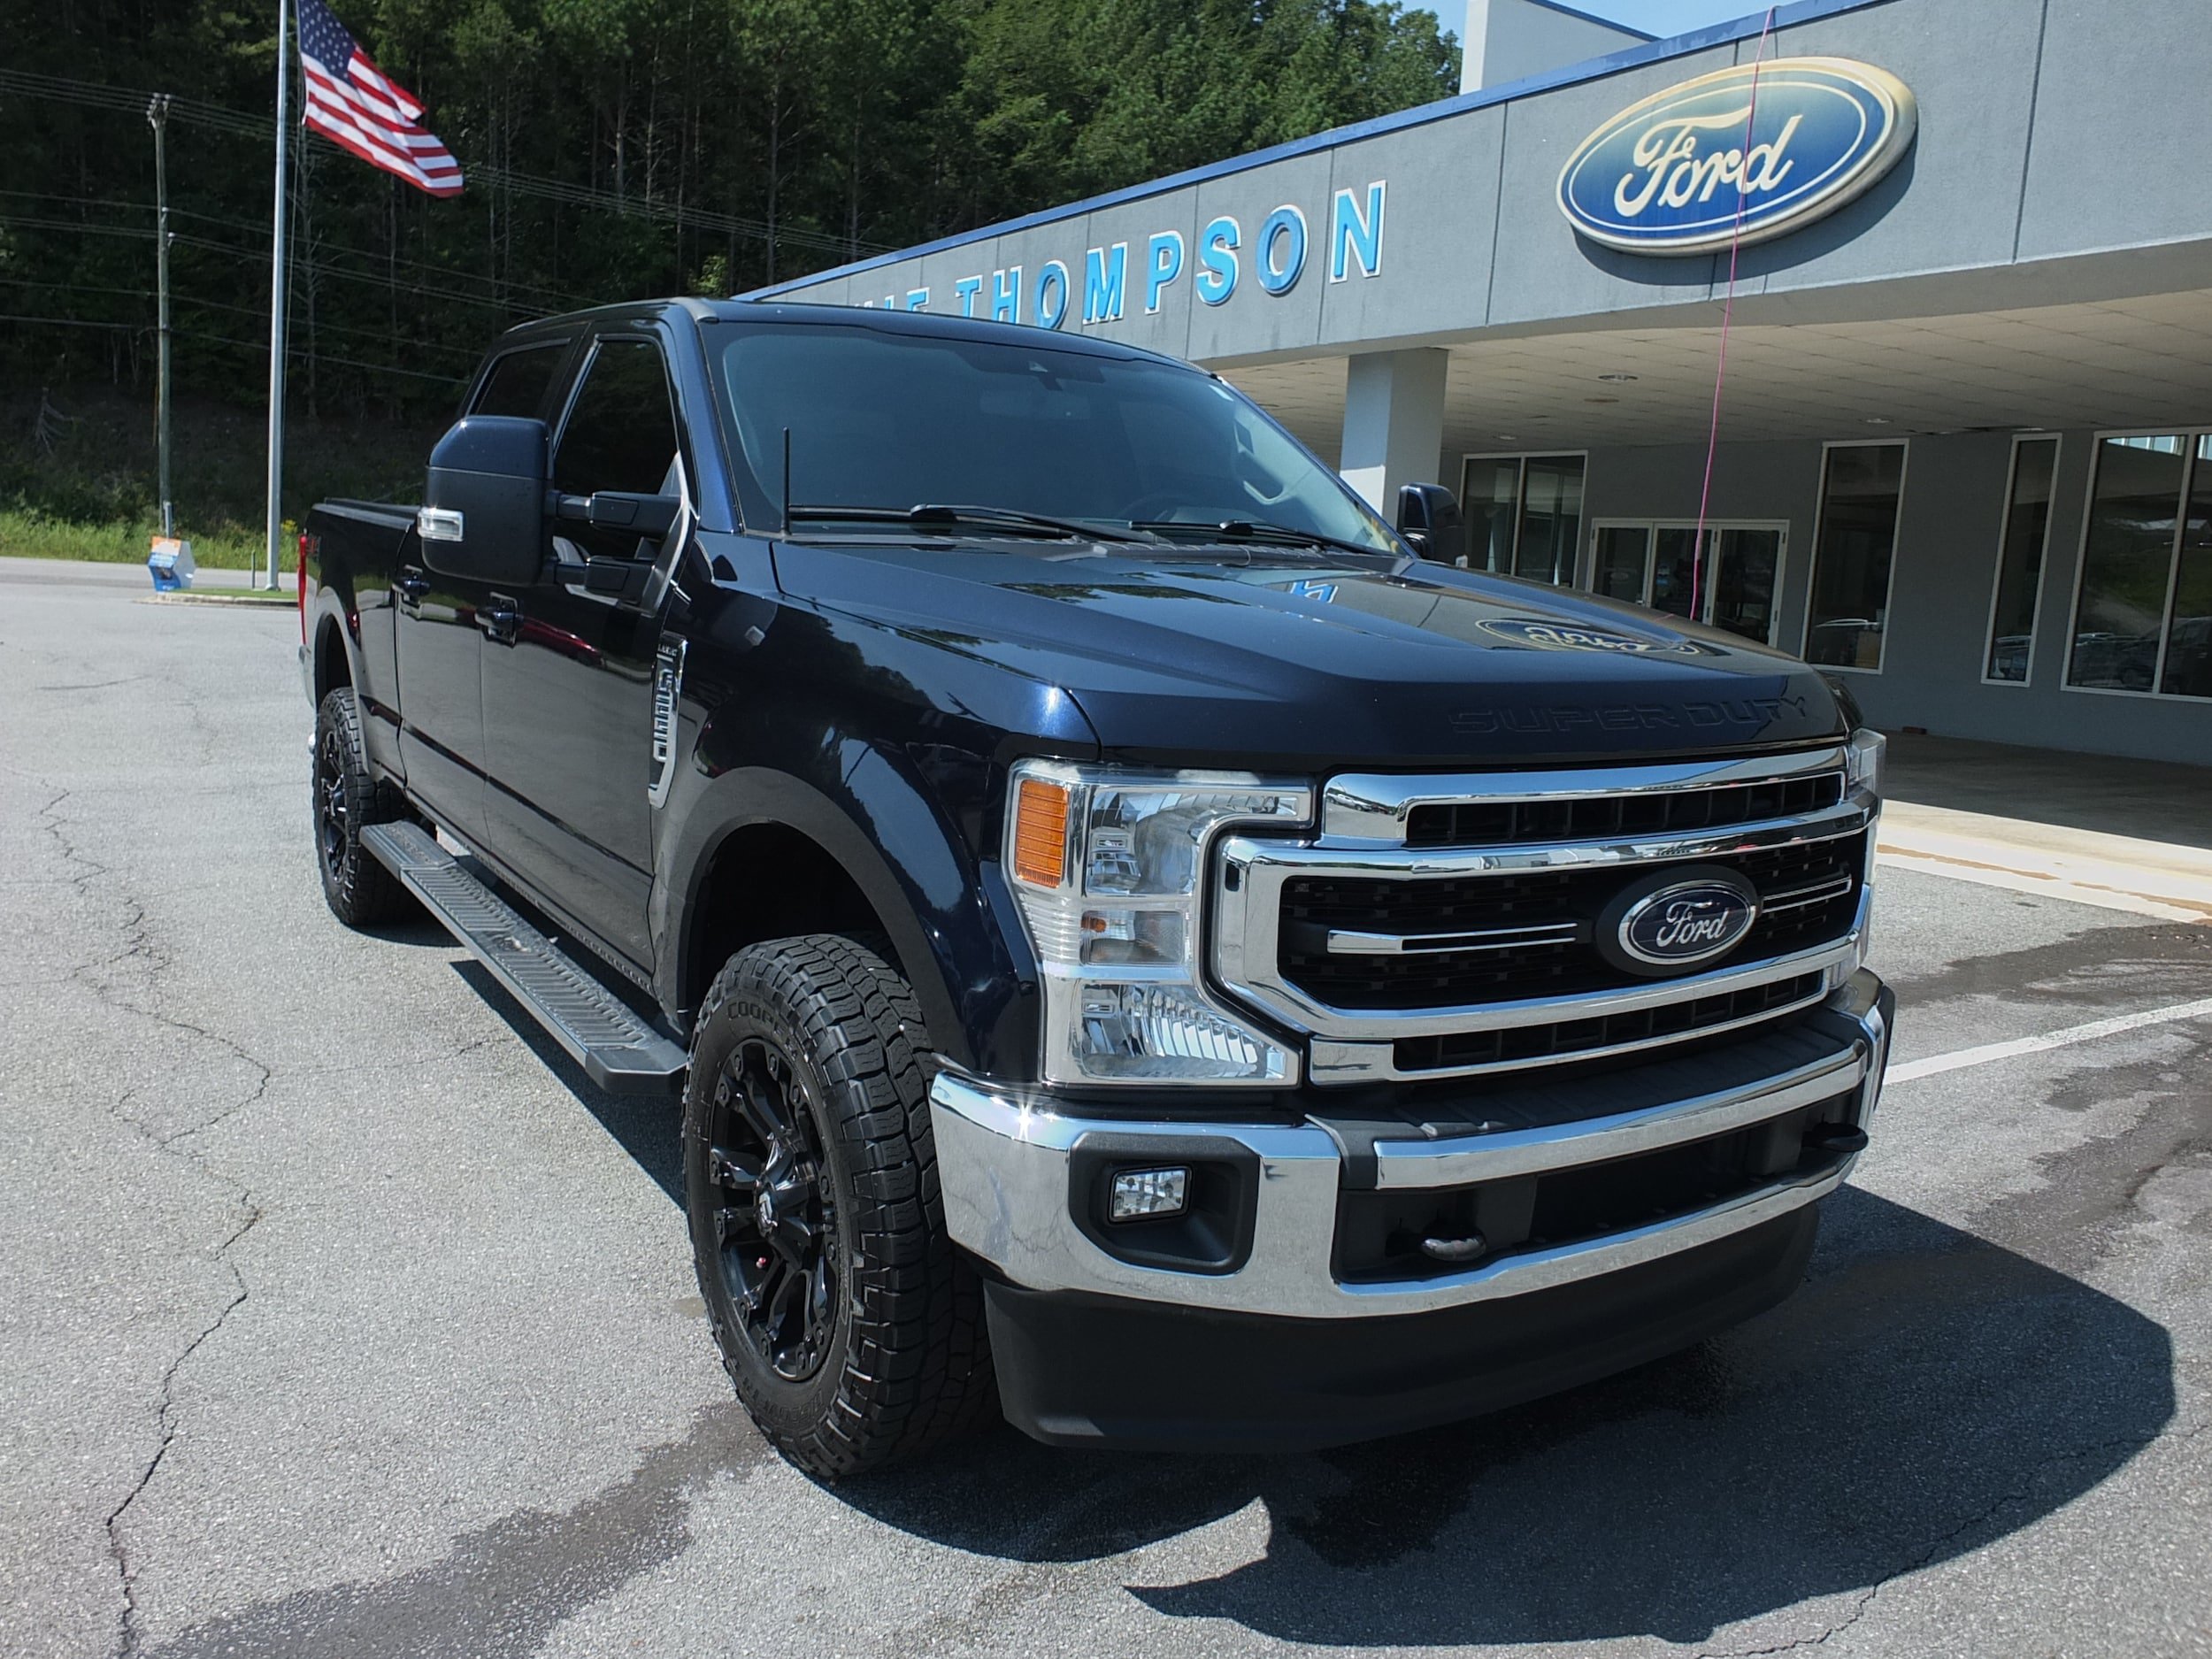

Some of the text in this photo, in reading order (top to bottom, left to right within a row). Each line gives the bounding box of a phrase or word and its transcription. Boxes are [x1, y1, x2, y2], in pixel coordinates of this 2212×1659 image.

[1613, 105, 1803, 217] Ford
[956, 180, 1386, 329] THOMPSON
[1449, 695, 1806, 734] SUPER DUTY
[1656, 901, 1729, 948] Ford
